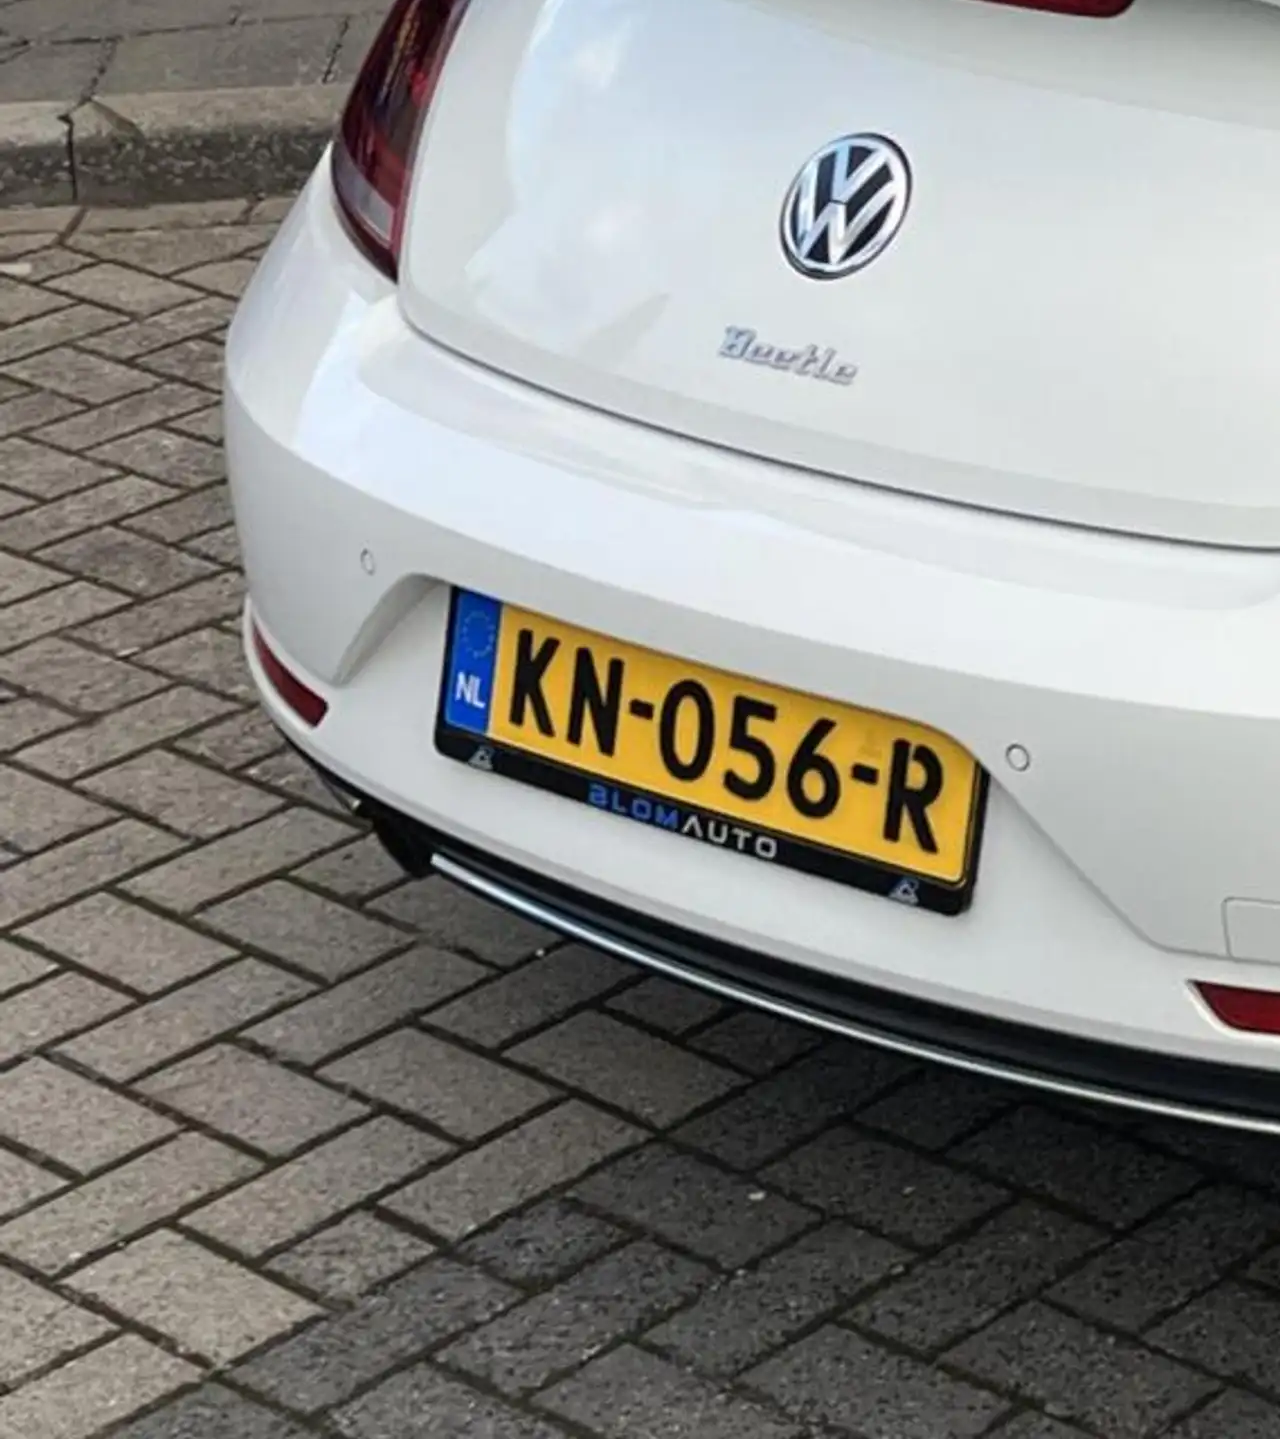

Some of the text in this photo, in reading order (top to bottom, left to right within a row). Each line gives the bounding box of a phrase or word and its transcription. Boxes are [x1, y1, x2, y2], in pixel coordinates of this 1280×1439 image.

[719, 324, 858, 387] Beetle
[455, 671, 487, 711] NL
[508, 627, 944, 854] KN-056-R
